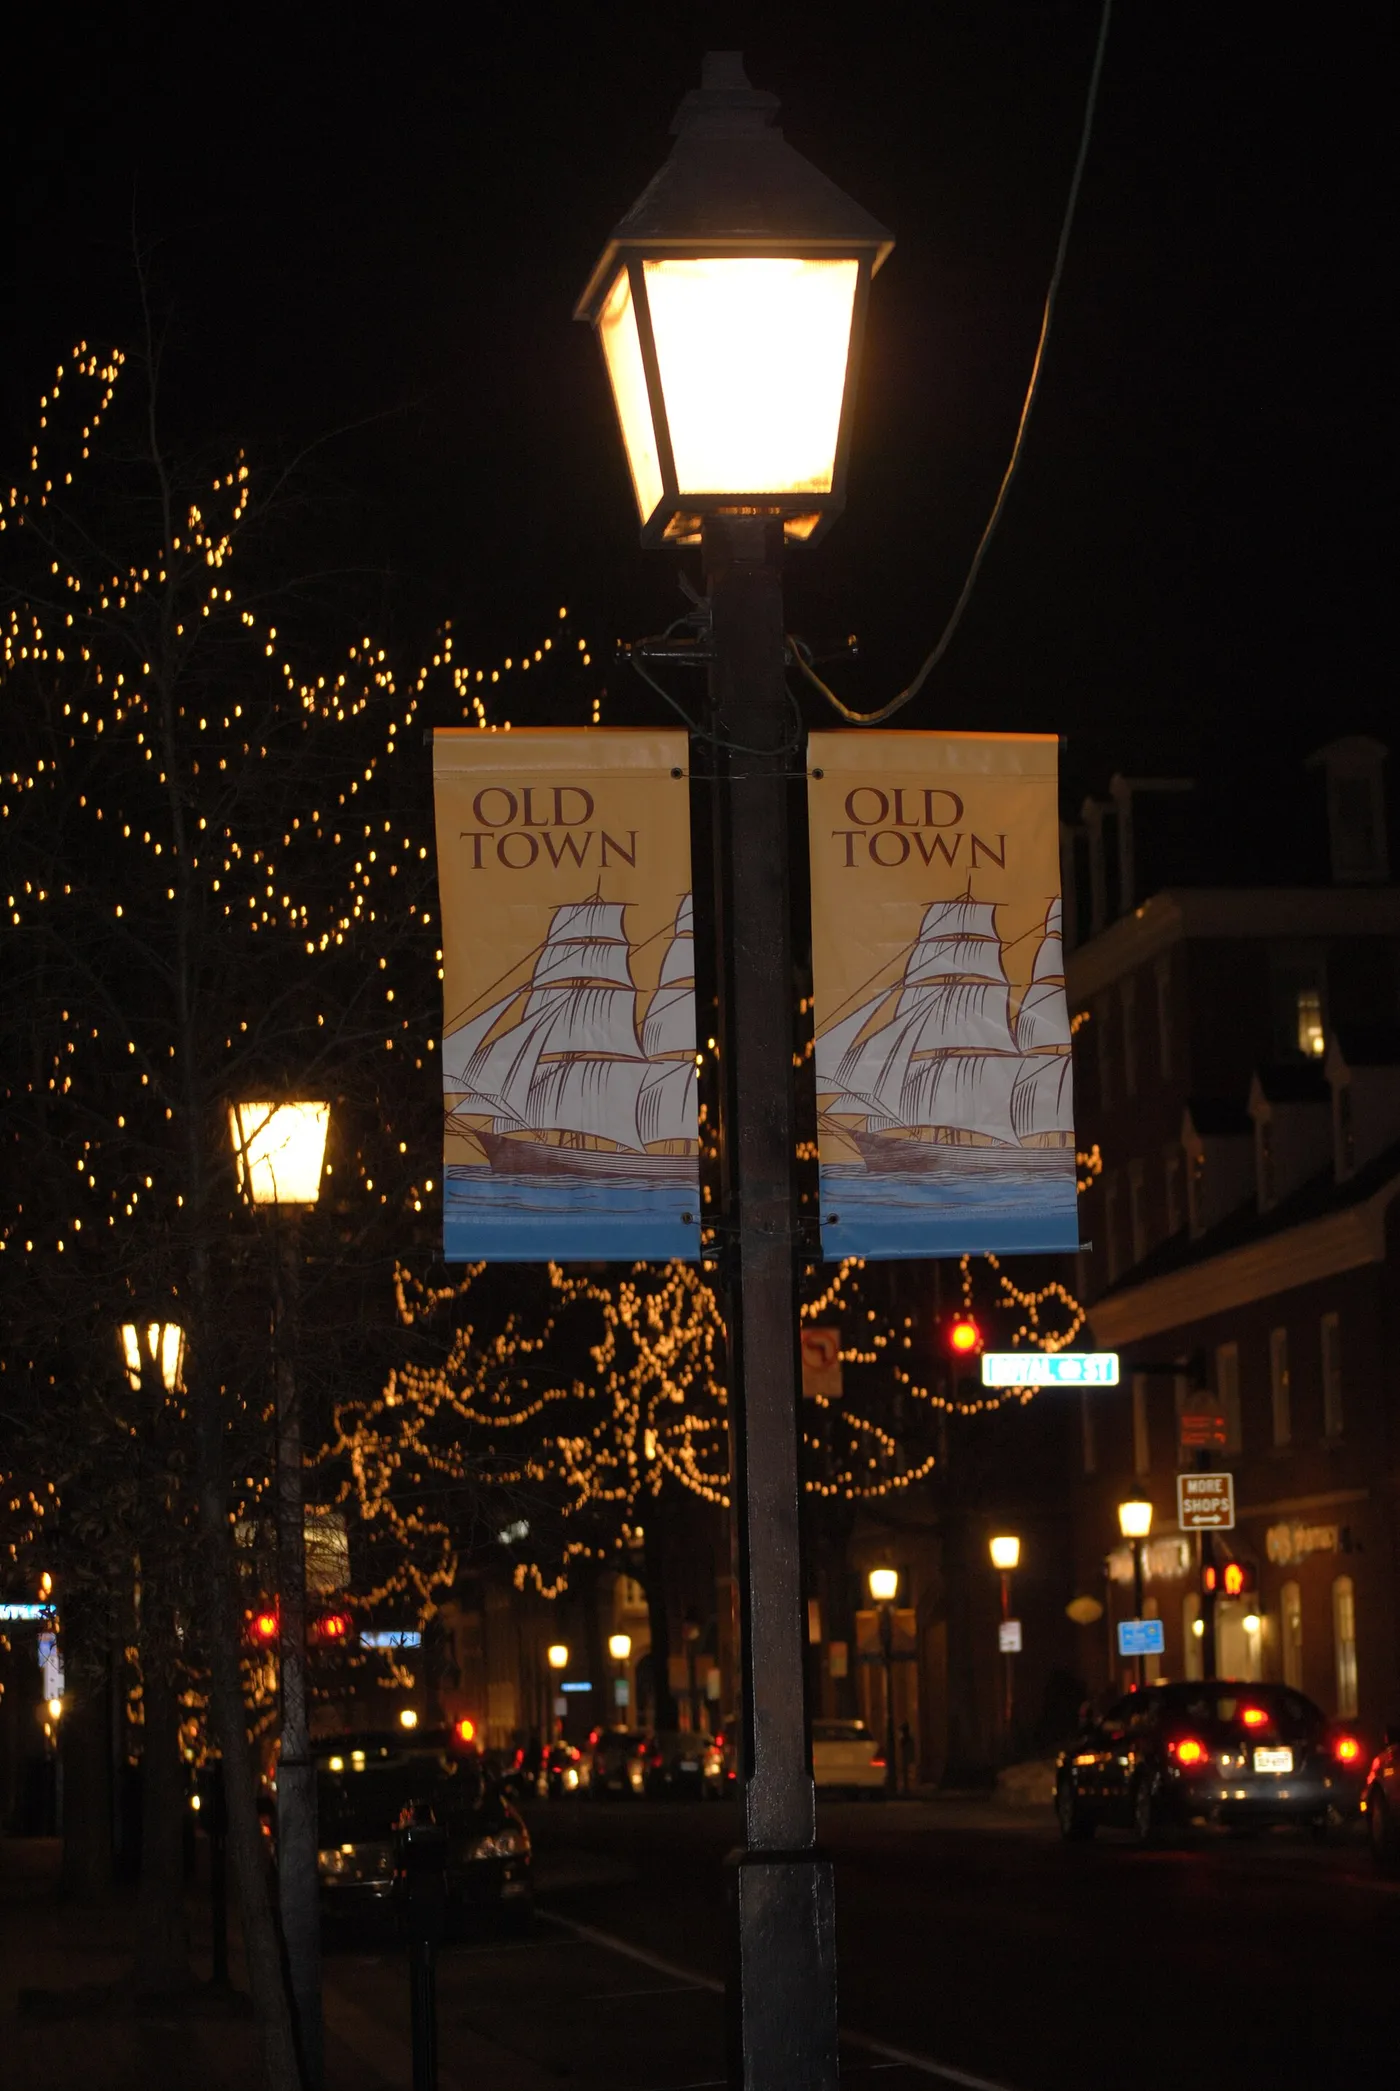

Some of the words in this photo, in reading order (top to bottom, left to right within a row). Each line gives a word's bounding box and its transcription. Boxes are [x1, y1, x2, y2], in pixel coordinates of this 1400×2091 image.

[472, 786, 595, 828] OLD
[844, 786, 965, 828] OLD
[460, 830, 639, 870] TOWN
[831, 829, 1008, 870] TOWN
[1183, 1498, 1230, 1513] SHOPS
[1186, 1478, 1224, 1494] MORE
